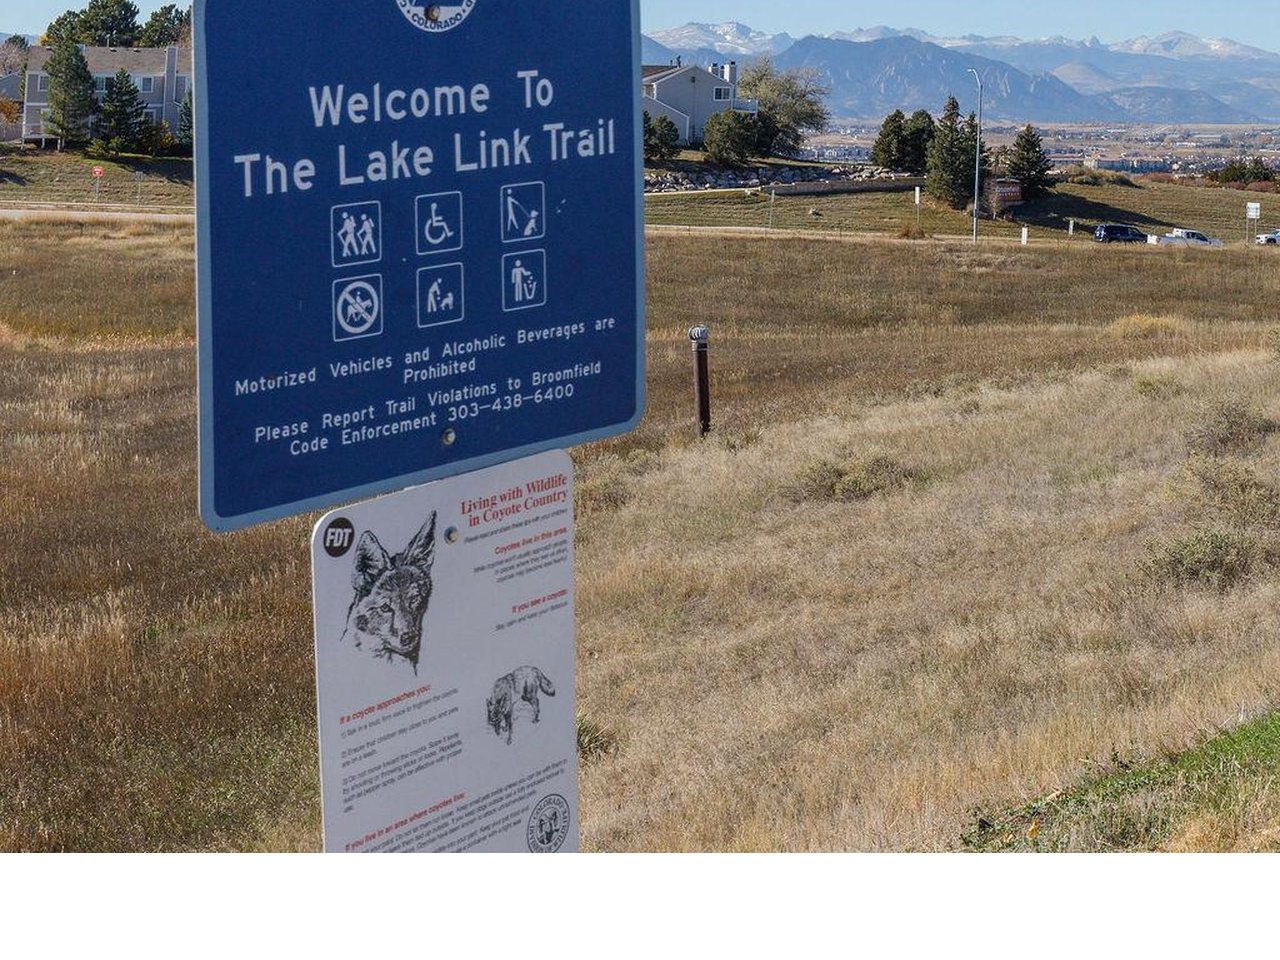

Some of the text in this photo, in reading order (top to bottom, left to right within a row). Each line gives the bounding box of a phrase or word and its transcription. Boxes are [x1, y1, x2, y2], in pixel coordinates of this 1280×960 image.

[411, 13, 463, 30] COLORADO
[309, 70, 554, 128] Welcome To
[234, 119, 615, 197] The Lake Link Trail
[235, 316, 615, 396] Motorized Vehicles and Alcoholic Beverages are
[404, 358, 476, 384] Prohibited
[255, 361, 601, 443] Please Report Trail Violations to Broomfield
[290, 384, 575, 456] Code Enforcement 303-438-6400
[461, 474, 567, 514] Living with Wildlife
[469, 489, 568, 527] in Coyote Country
[326, 527, 353, 548] FDT
